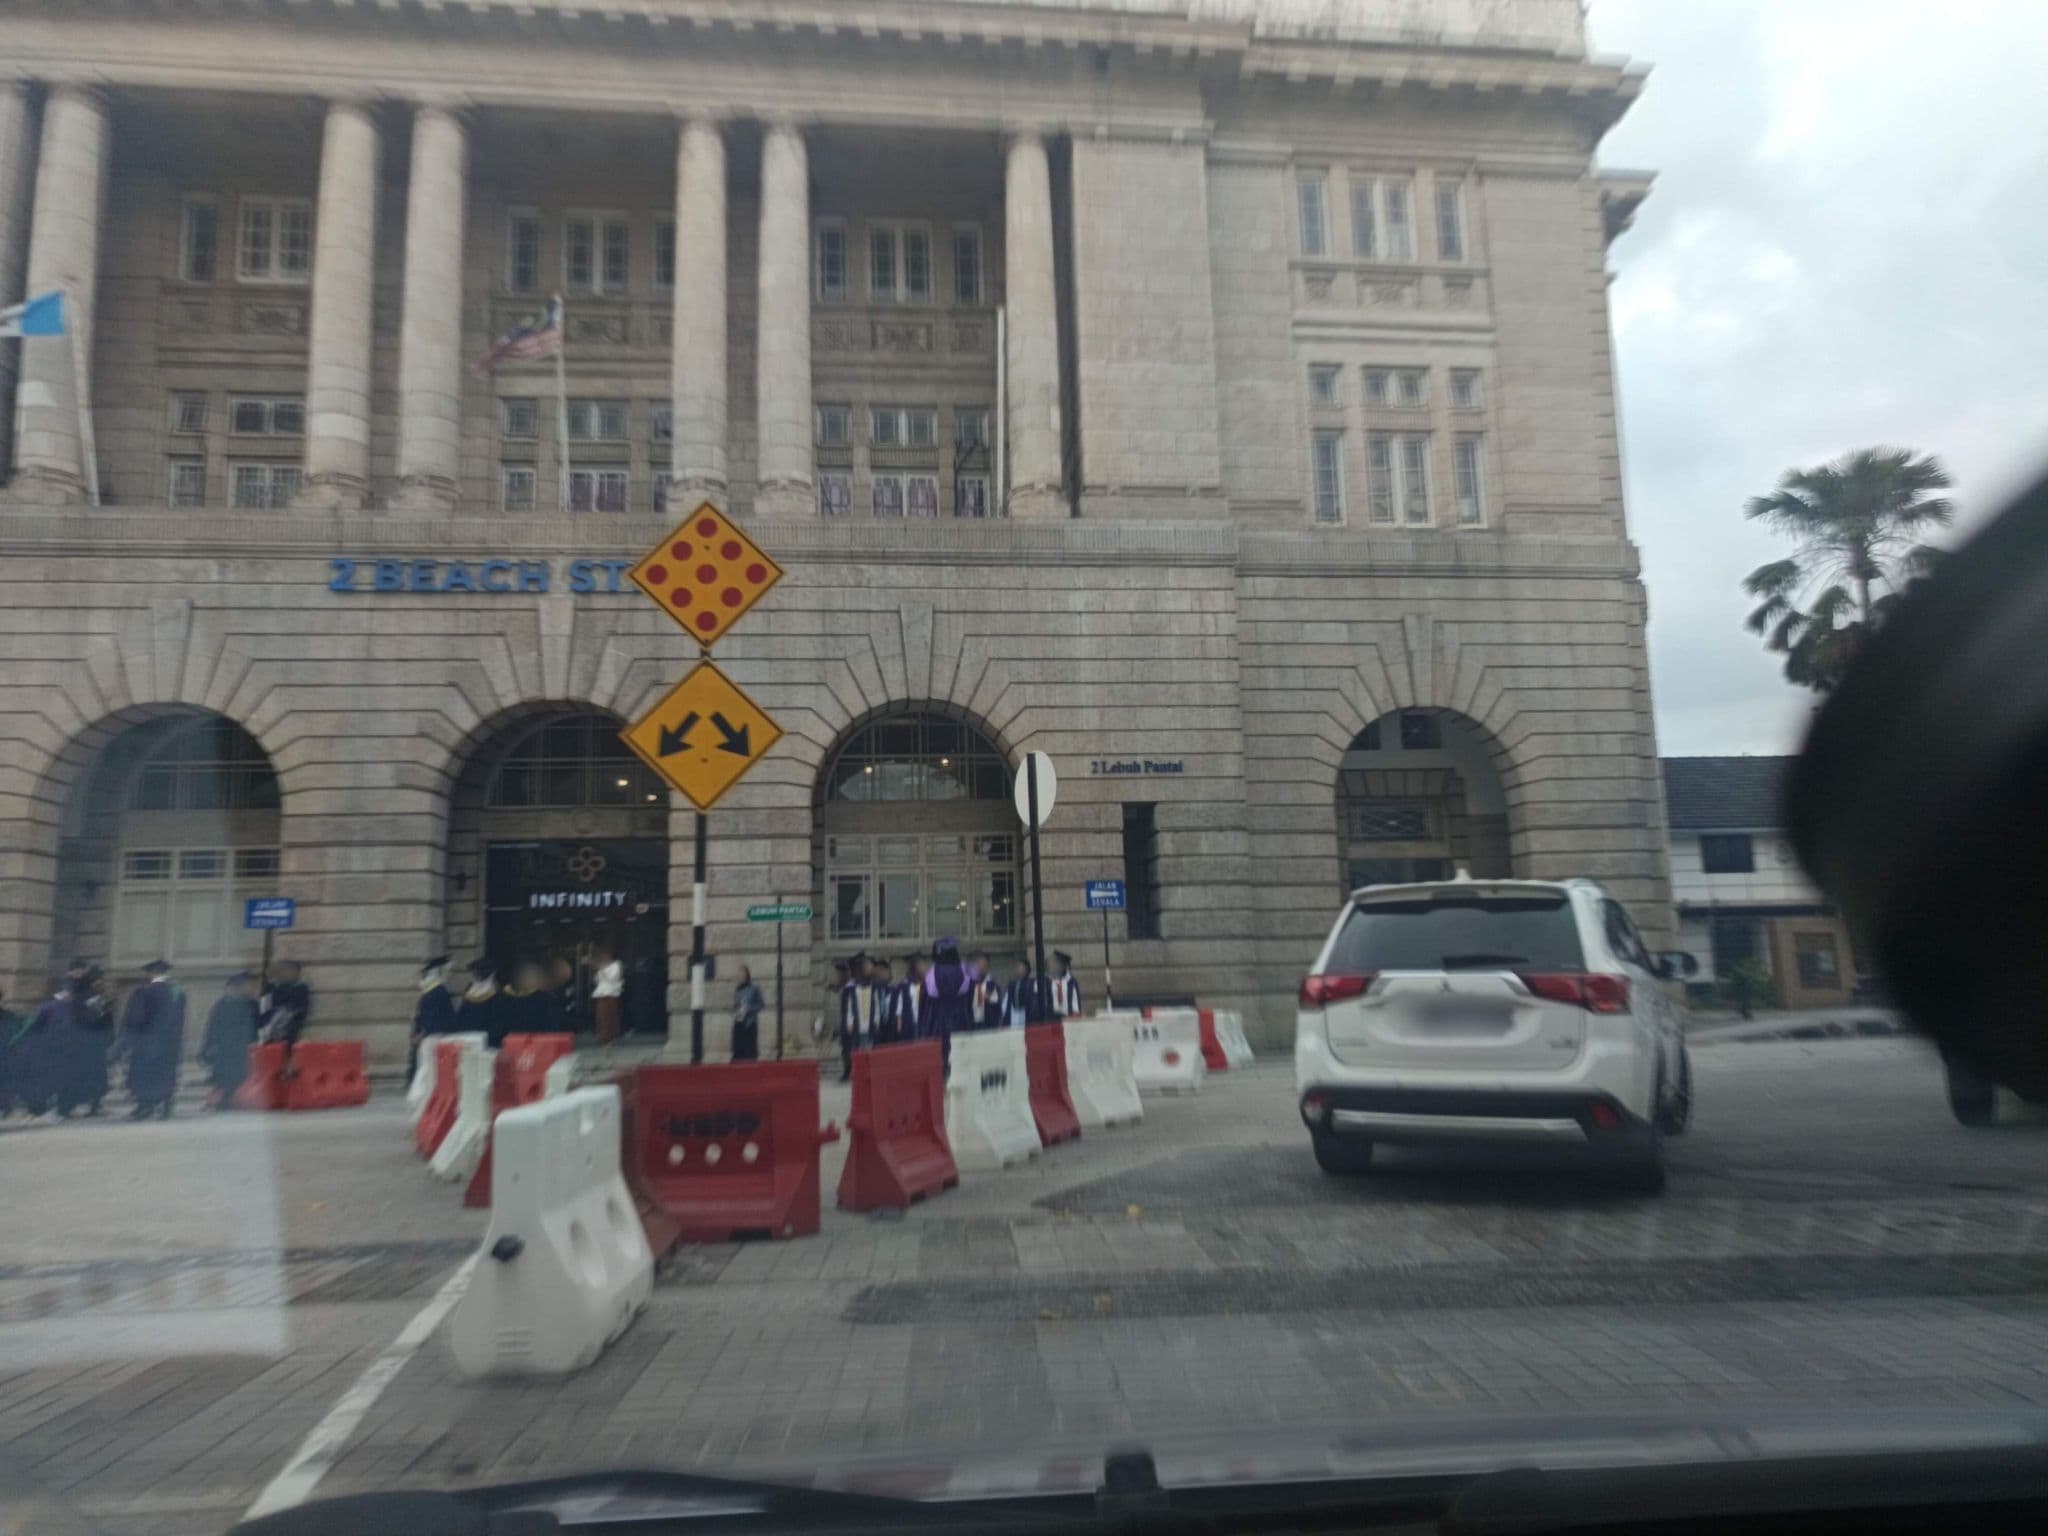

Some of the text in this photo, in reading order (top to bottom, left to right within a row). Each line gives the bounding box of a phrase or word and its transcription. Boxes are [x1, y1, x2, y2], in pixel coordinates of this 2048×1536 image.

[329, 558, 641, 593] 2 BEACH ST
[1092, 759, 1183, 774] 2 Lebuh Pantai
[529, 890, 627, 908] INFINITY
